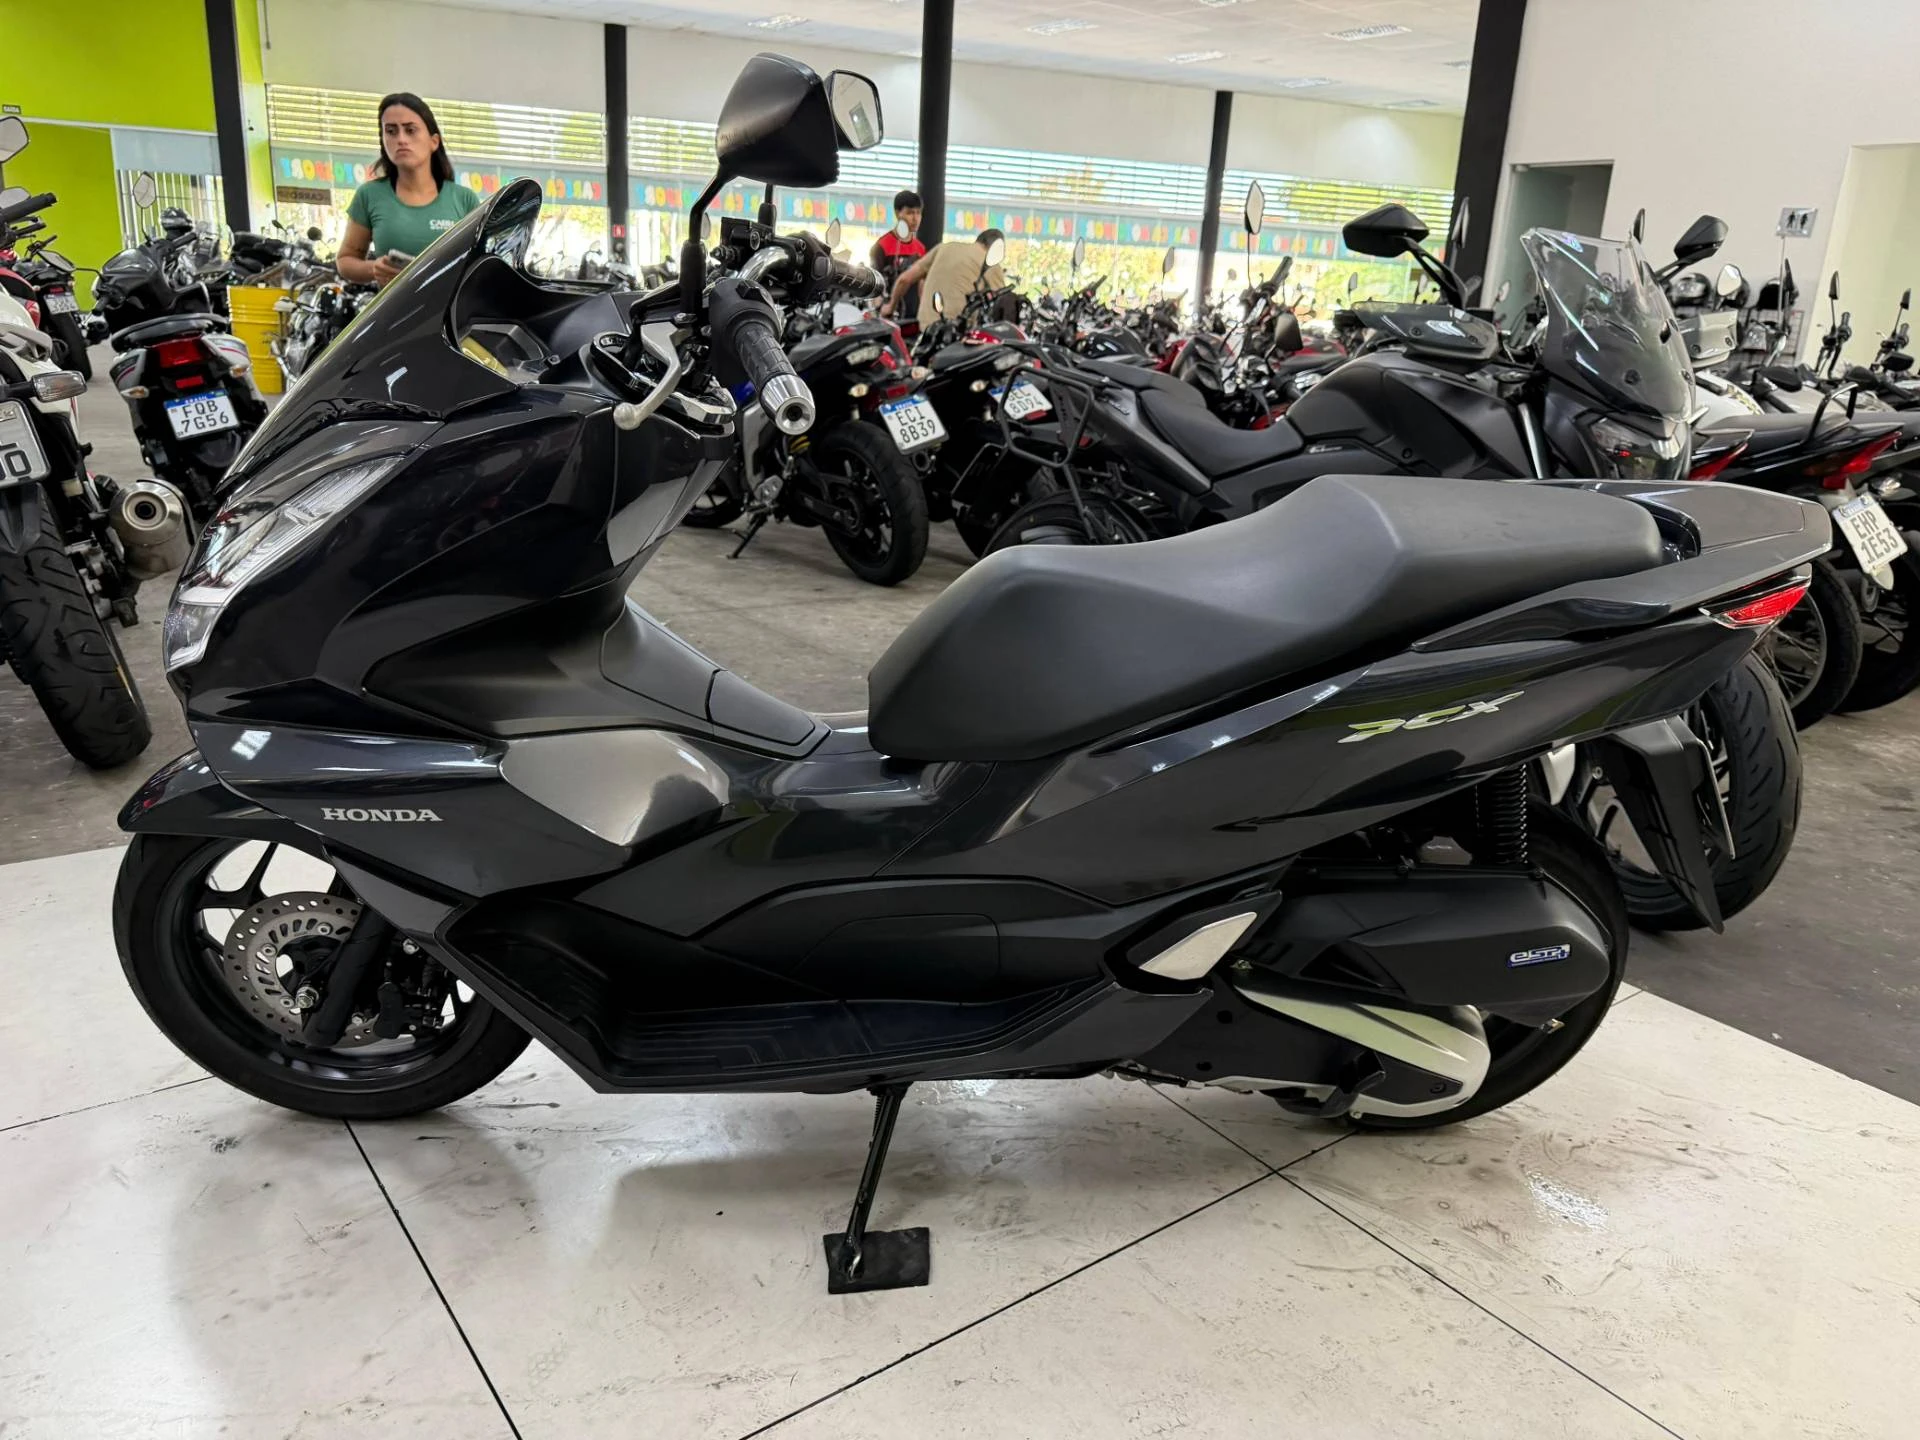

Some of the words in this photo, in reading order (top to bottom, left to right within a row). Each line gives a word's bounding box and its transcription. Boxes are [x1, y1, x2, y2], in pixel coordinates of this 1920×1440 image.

[182, 400, 218, 418] FQB
[895, 406, 925, 426] ECI
[181, 411, 229, 432] 7G56
[900, 419, 935, 443] 8B39
[1850, 510, 1879, 538] EHP
[1860, 528, 1898, 563] 1E53
[320, 807, 445, 822] HONDA
